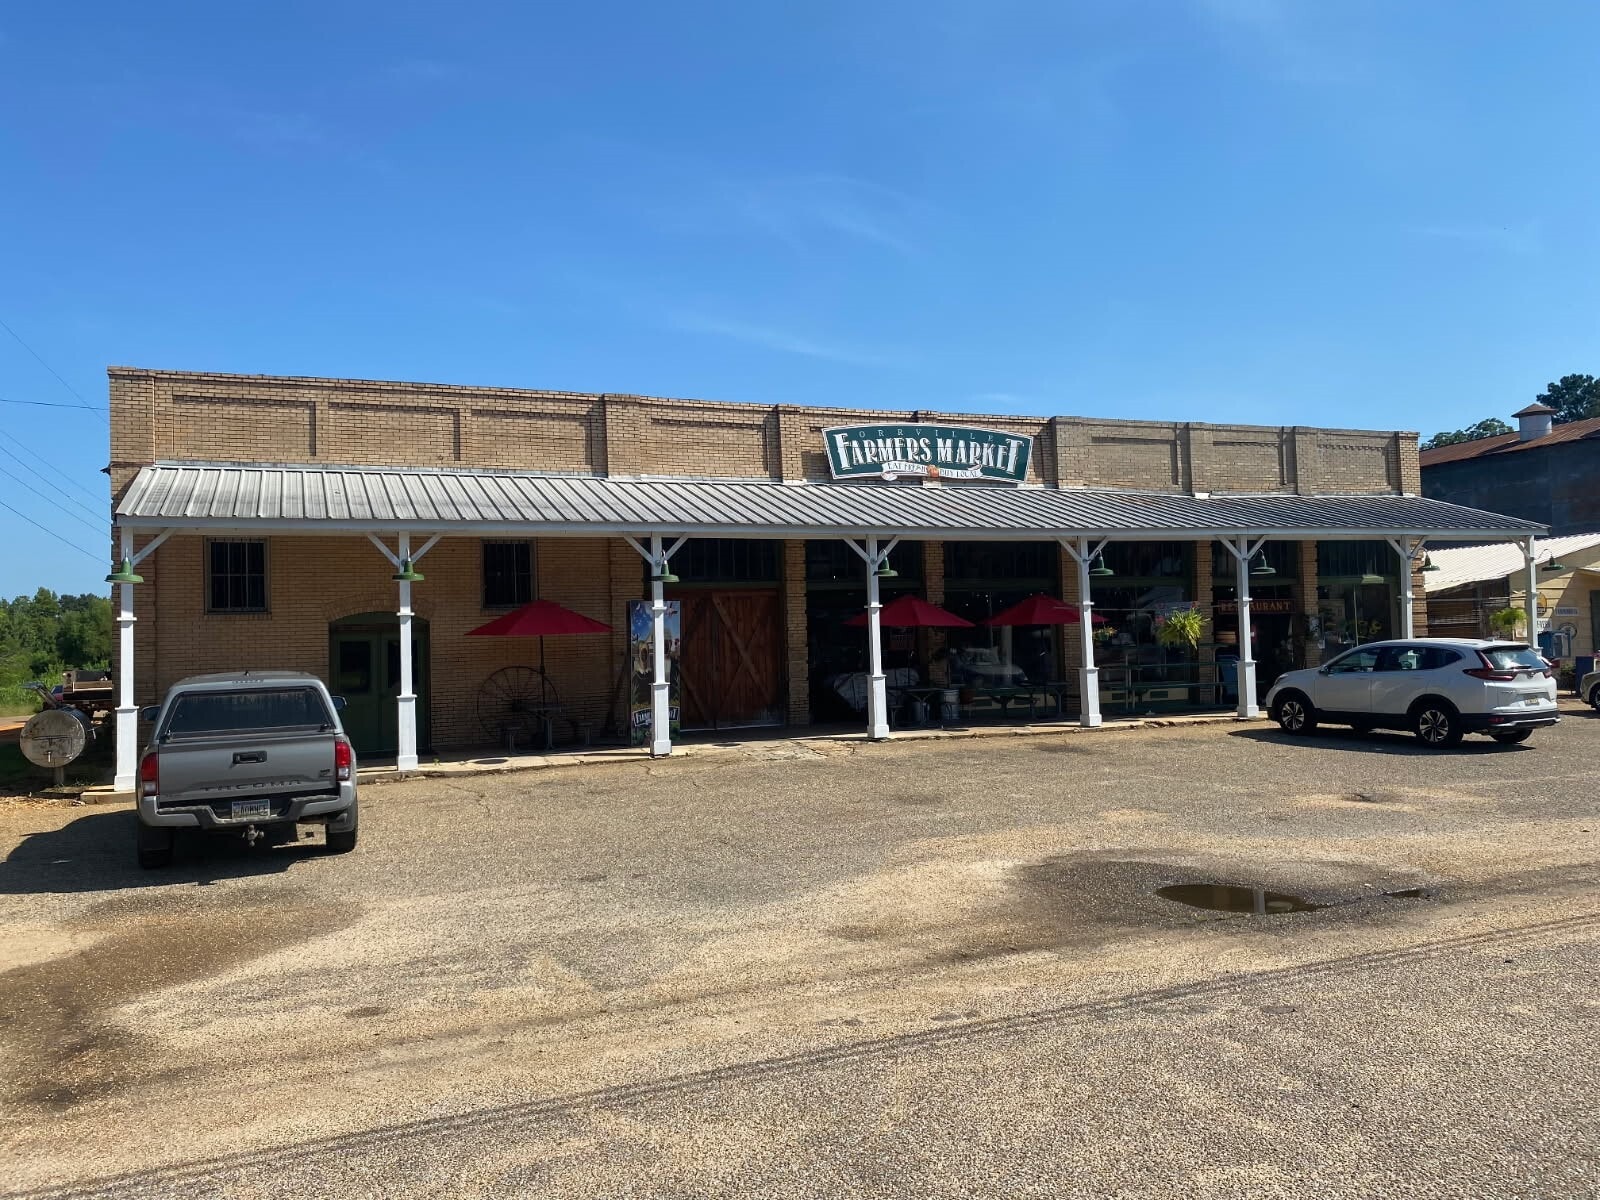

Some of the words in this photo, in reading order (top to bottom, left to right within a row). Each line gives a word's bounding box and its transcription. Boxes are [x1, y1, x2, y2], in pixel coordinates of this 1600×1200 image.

[858, 428, 994, 442] ORRVILLE
[833, 432, 932, 470] FARMERS
[936, 438, 1025, 475] MARKET
[200, 779, 301, 792] TACOMA
